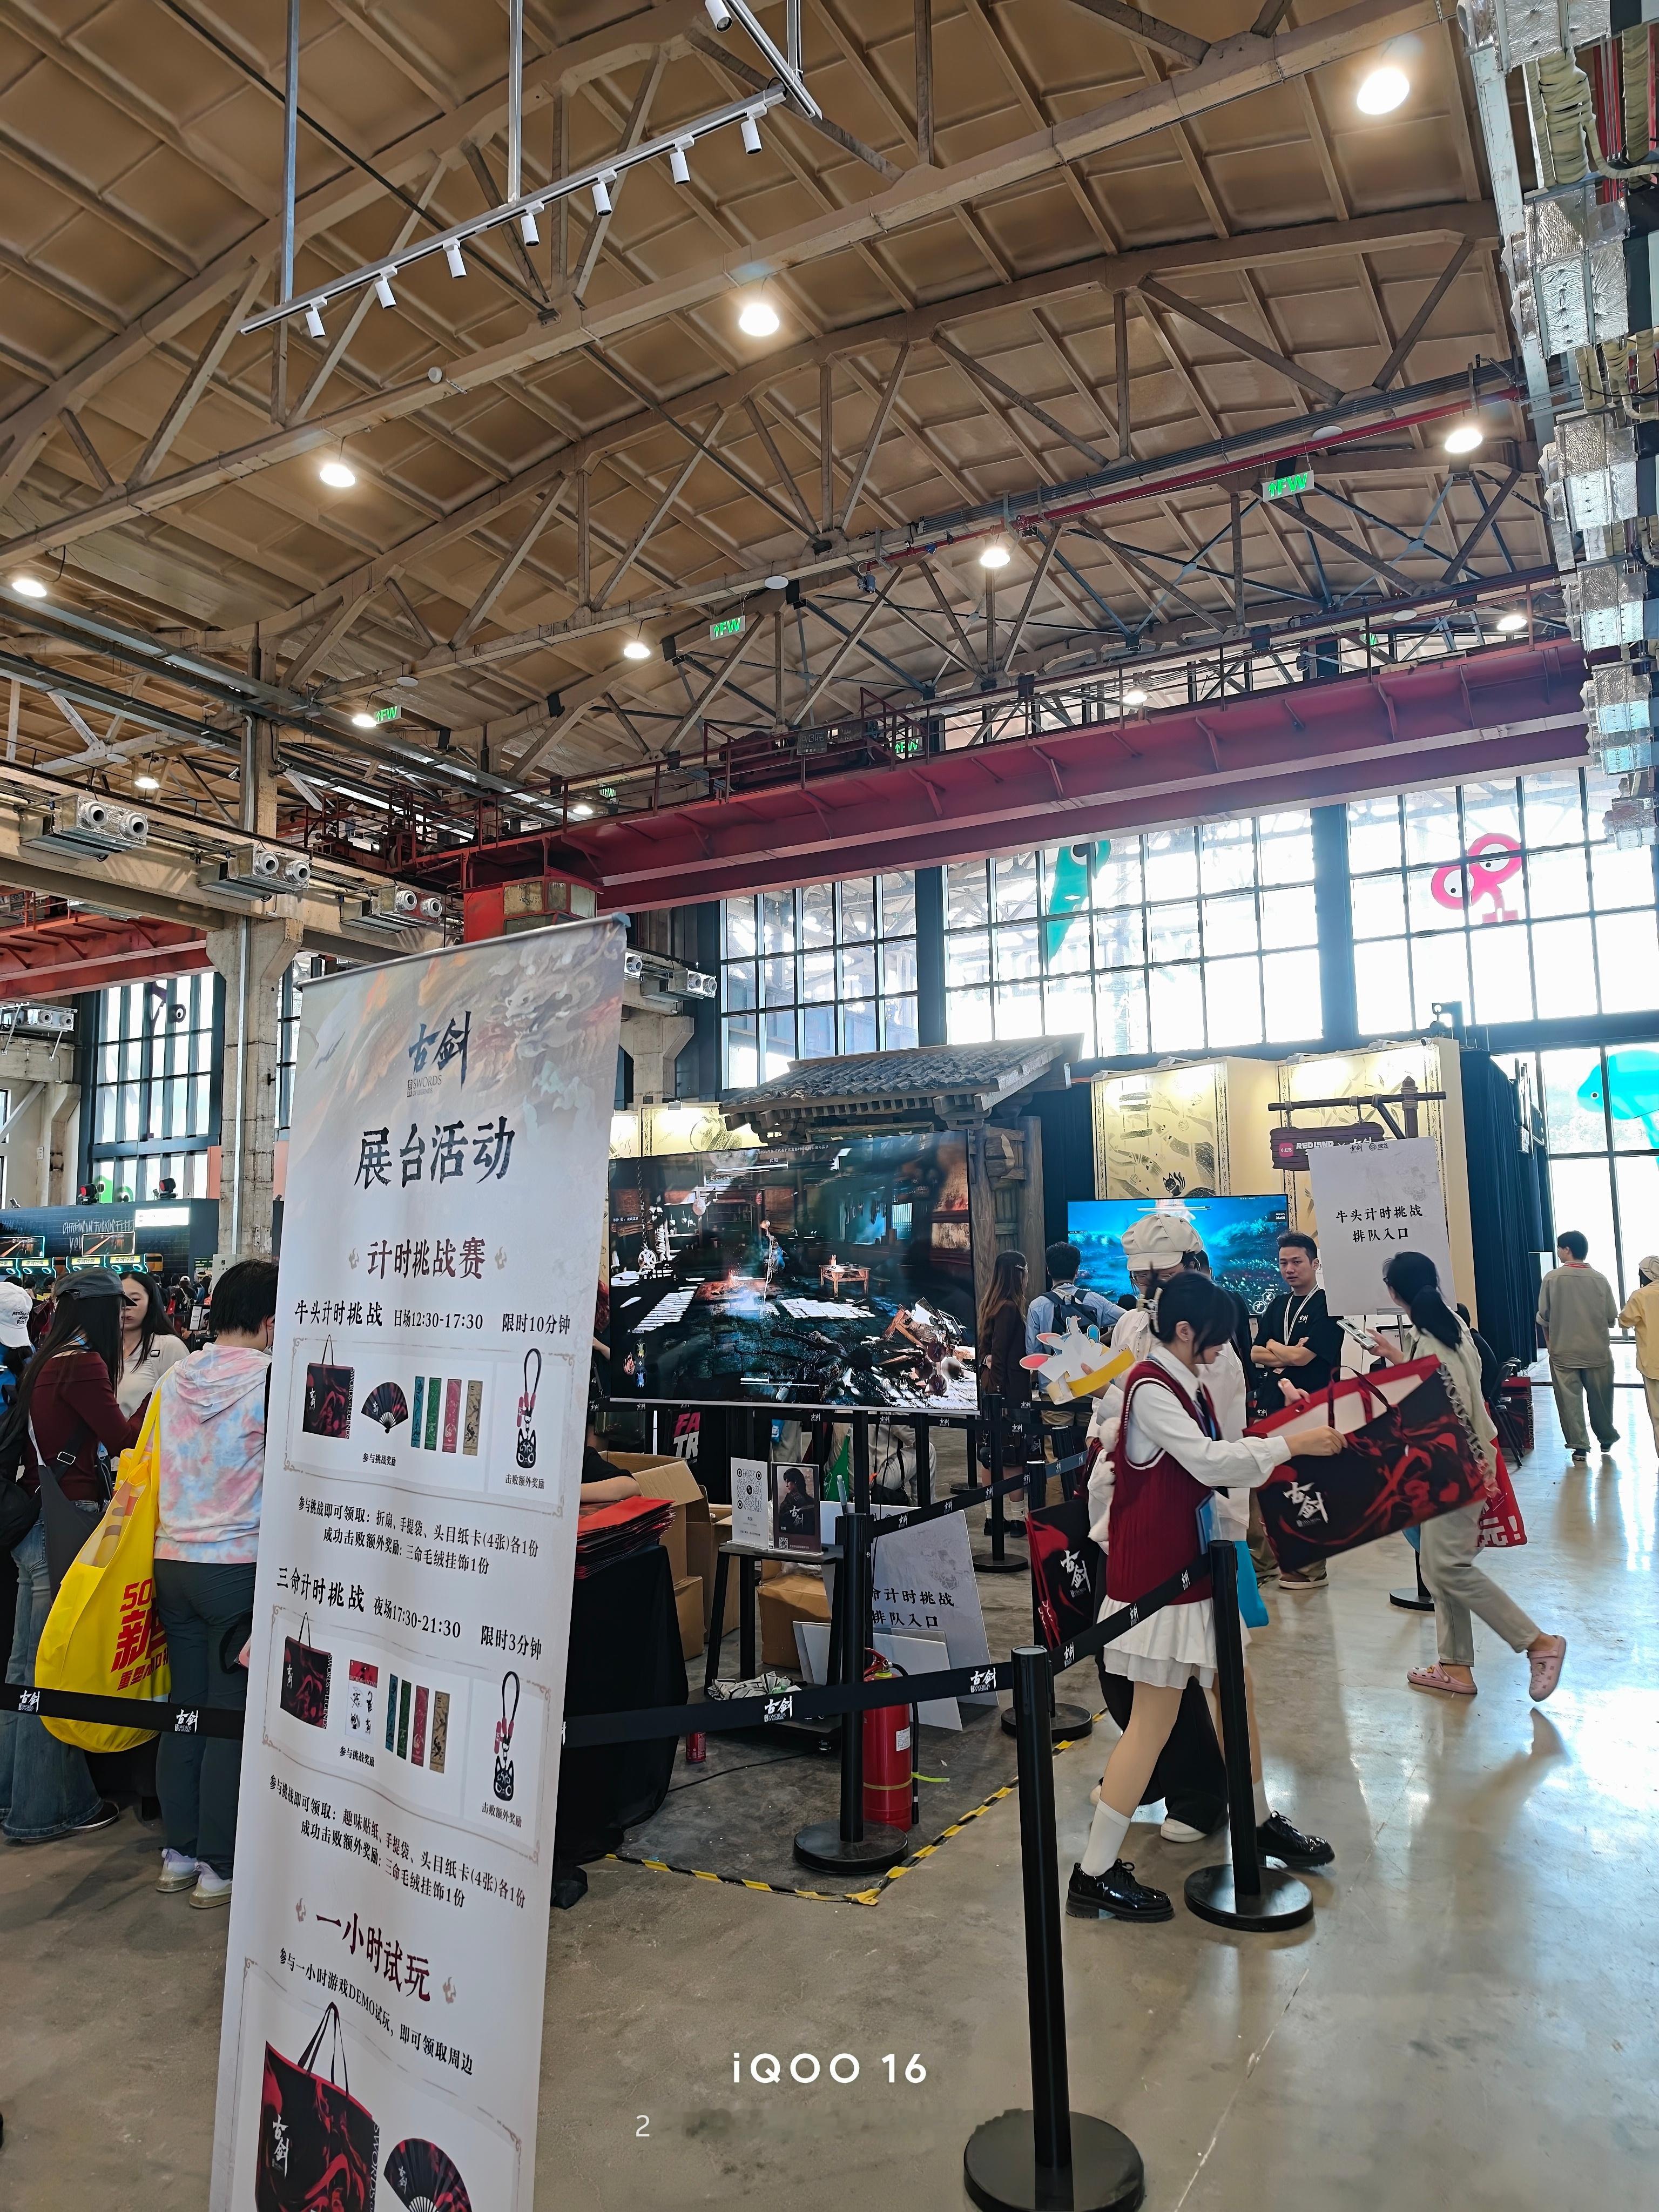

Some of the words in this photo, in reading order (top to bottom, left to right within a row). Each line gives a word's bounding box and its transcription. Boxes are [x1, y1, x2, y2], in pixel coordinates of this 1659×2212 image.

[409, 1011, 472, 1090] 古剑
[413, 1075, 442, 1089] SWORDS
[354, 1116, 515, 1189] 展台活动
[1336, 1204, 1423, 1223] 牛头计时挑战
[1352, 1228, 1408, 1243] 排队入口
[367, 1237, 486, 1279] 计时挑战赛
[294, 1299, 383, 1327] 牛头计时挑战
[394, 1309, 483, 1330] 日场12:30-17:30
[502, 1313, 571, 1336] 限时10分钟
[362, 1452, 396, 1466] 参与挑战奖励
[505, 1473, 545, 1490] 击败额外奖励
[1283, 1481, 1328, 1523] 古剑
[1060, 1549, 1091, 1594] 古剑
[276, 1567, 365, 1613] 三命计时挑战
[373, 1596, 461, 1638] 夜场17:30-21:30
[481, 1624, 542, 1661] 限时3分钟
[872, 1610, 938, 1628] 排队入口
[970, 1667, 996, 1690] 古剑
[20, 1690, 41, 1713] 古剑
[764, 1695, 793, 1718] 古剑
[176, 1709, 199, 1734] 古剑
[340, 1745, 375, 1767] 参与挑战奖励
[482, 1802, 522, 1827] 击败额外奖励
[316, 1913, 430, 2001] 一小时试玩
[272, 2114, 289, 2177] 古剑
[369, 2123, 380, 2198] SWORDS
[398, 2166, 407, 2195] 古剑
